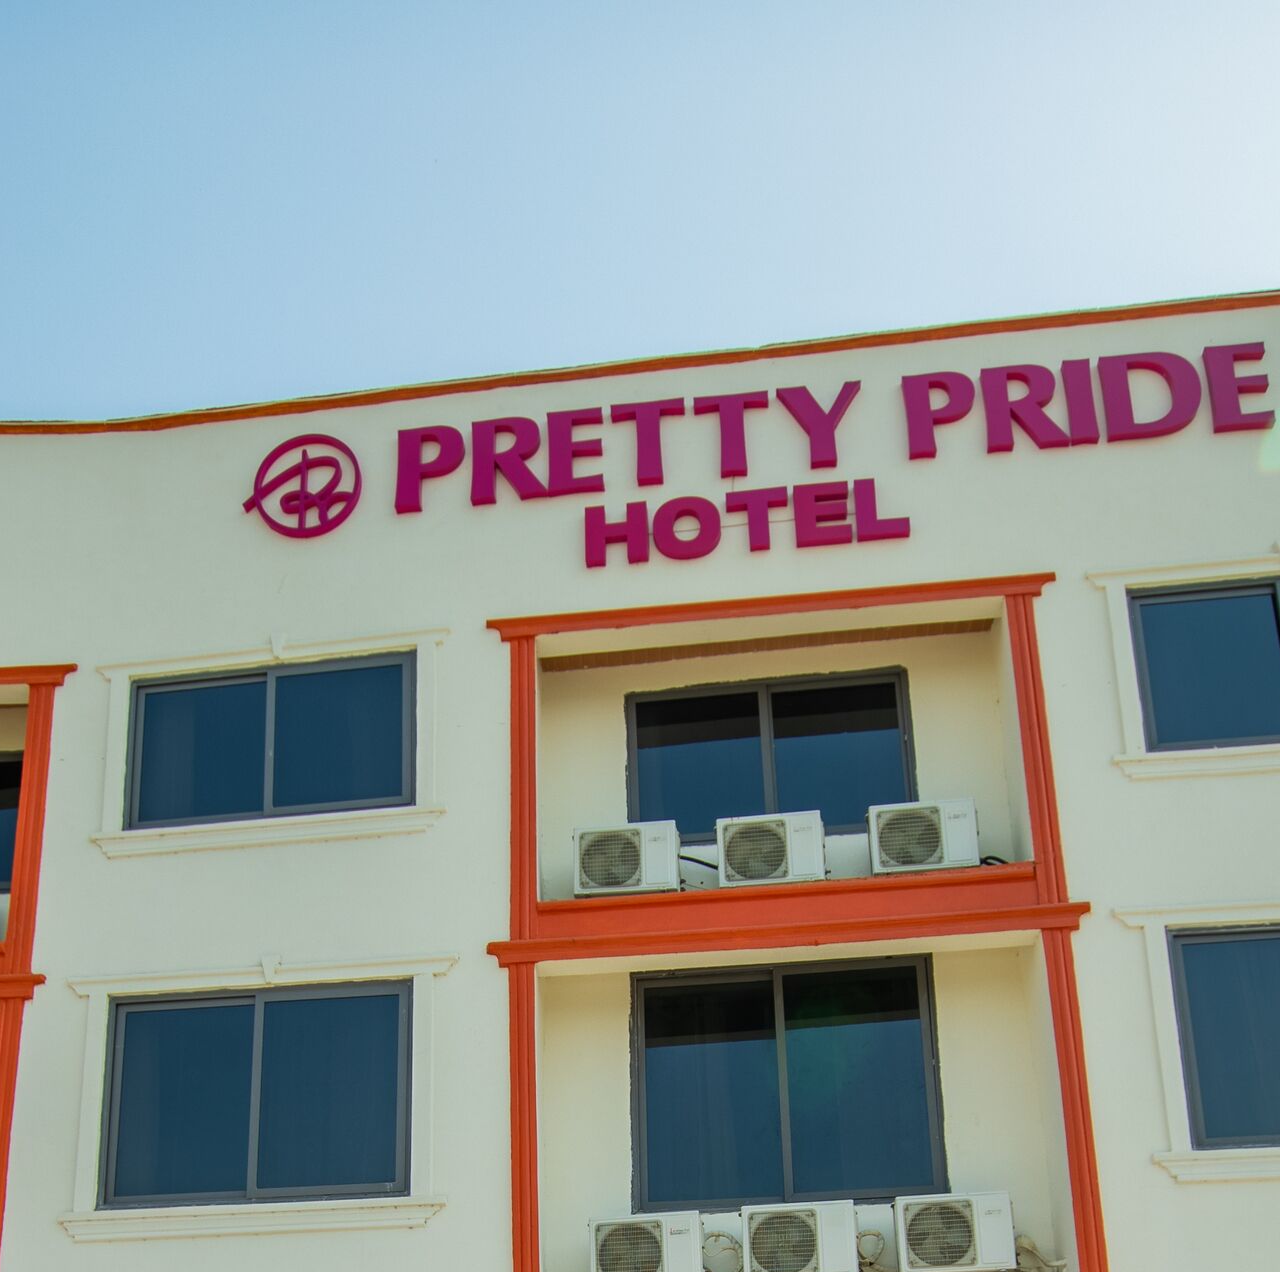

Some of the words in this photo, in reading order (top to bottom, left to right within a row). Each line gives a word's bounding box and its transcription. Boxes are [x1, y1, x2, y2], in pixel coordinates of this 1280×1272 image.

[393, 380, 861, 515] PRETTY
[901, 341, 1275, 461] PRIDE
[583, 478, 911, 568] HOTEL
